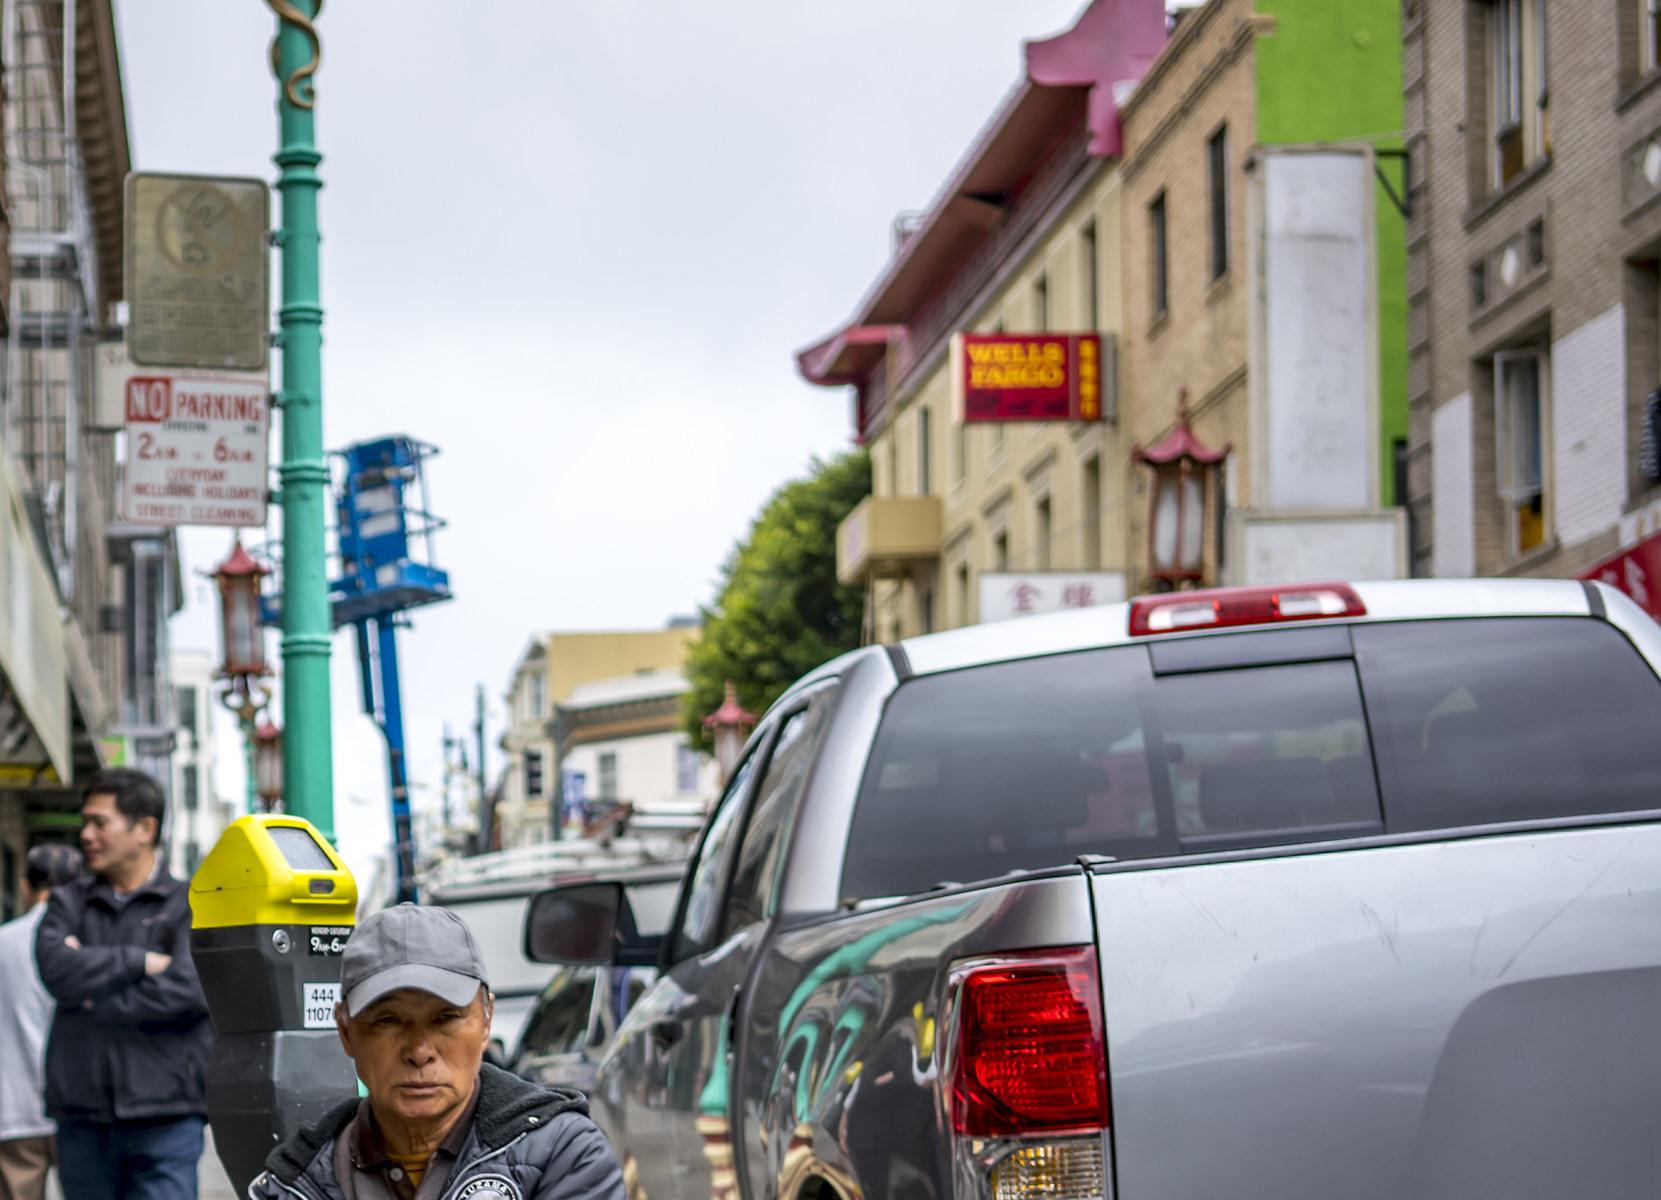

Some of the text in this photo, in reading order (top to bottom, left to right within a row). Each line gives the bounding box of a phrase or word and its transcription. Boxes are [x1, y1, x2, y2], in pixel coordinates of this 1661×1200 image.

[967, 342, 1065, 365] WELLS
[969, 364, 1065, 389] FARGO
[131, 380, 261, 421] NO PARKING
[137, 431, 178, 461] 2AM
[213, 435, 254, 464] 6AM
[165, 467, 227, 482] EVERYDAY
[132, 483, 259, 500] INCLUDING HOLIDAYS
[135, 503, 256, 521] STREET CLEANING
[311, 989, 334, 1001] 444
[306, 1007, 336, 1021] 1107
